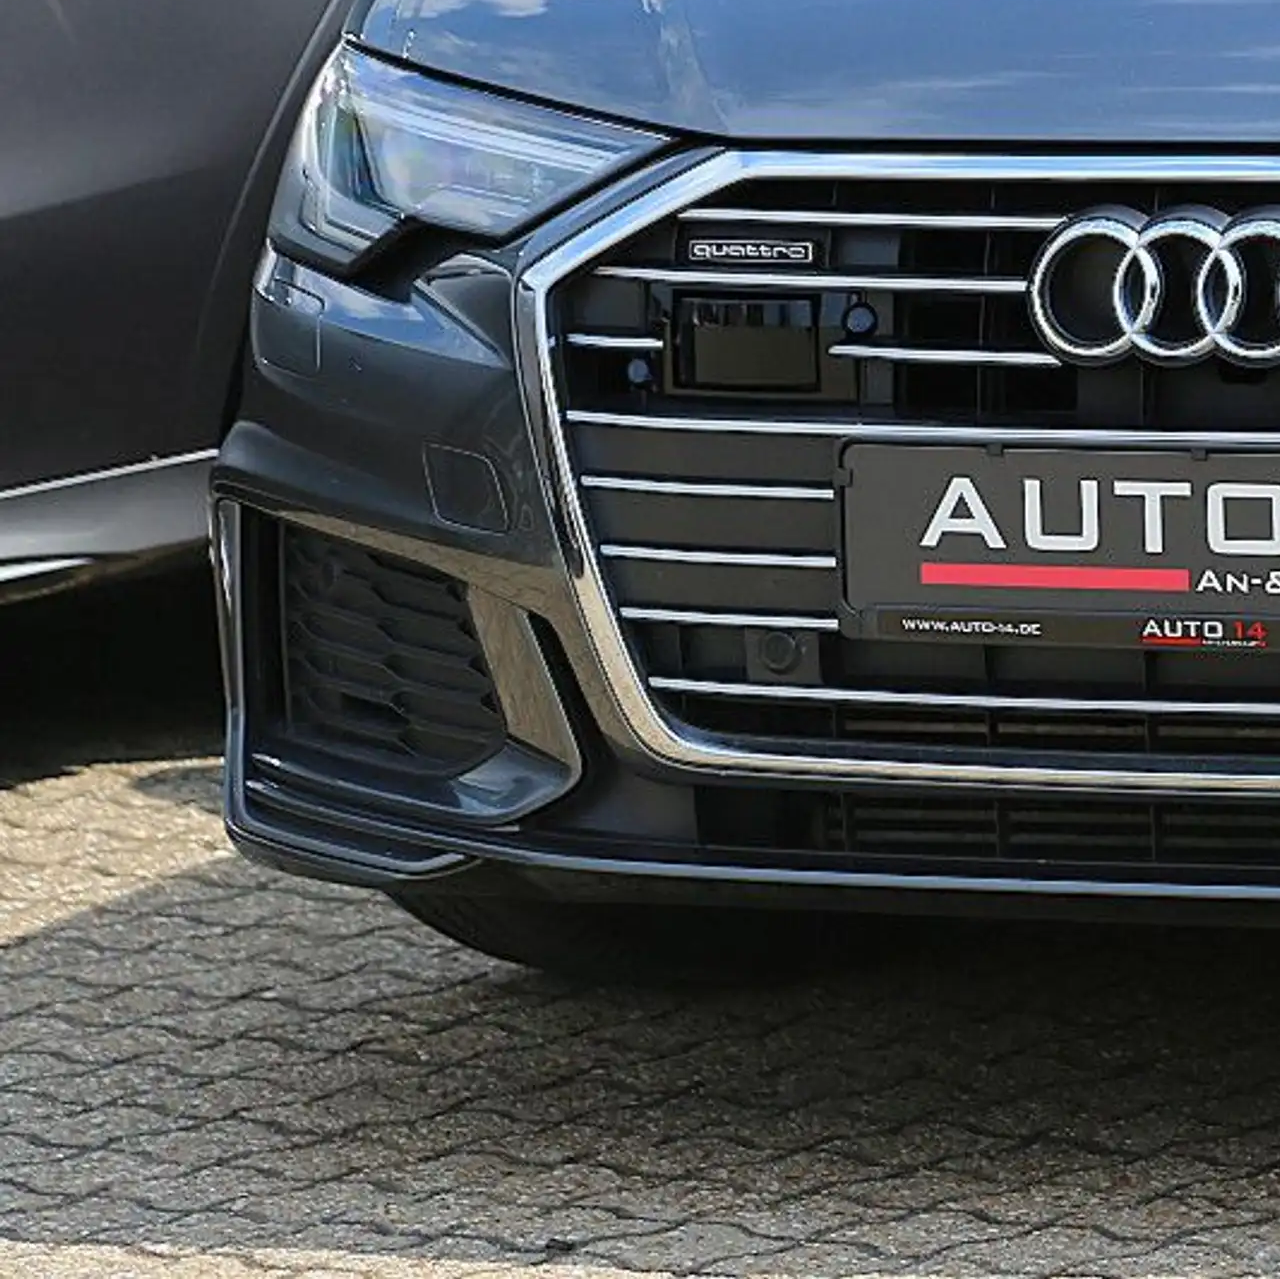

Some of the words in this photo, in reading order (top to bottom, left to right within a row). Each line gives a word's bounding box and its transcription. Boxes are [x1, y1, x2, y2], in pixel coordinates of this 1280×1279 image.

[693, 243, 806, 258] quattro
[1142, 619, 1224, 638] AUTO
[1232, 620, 1268, 640] 14
